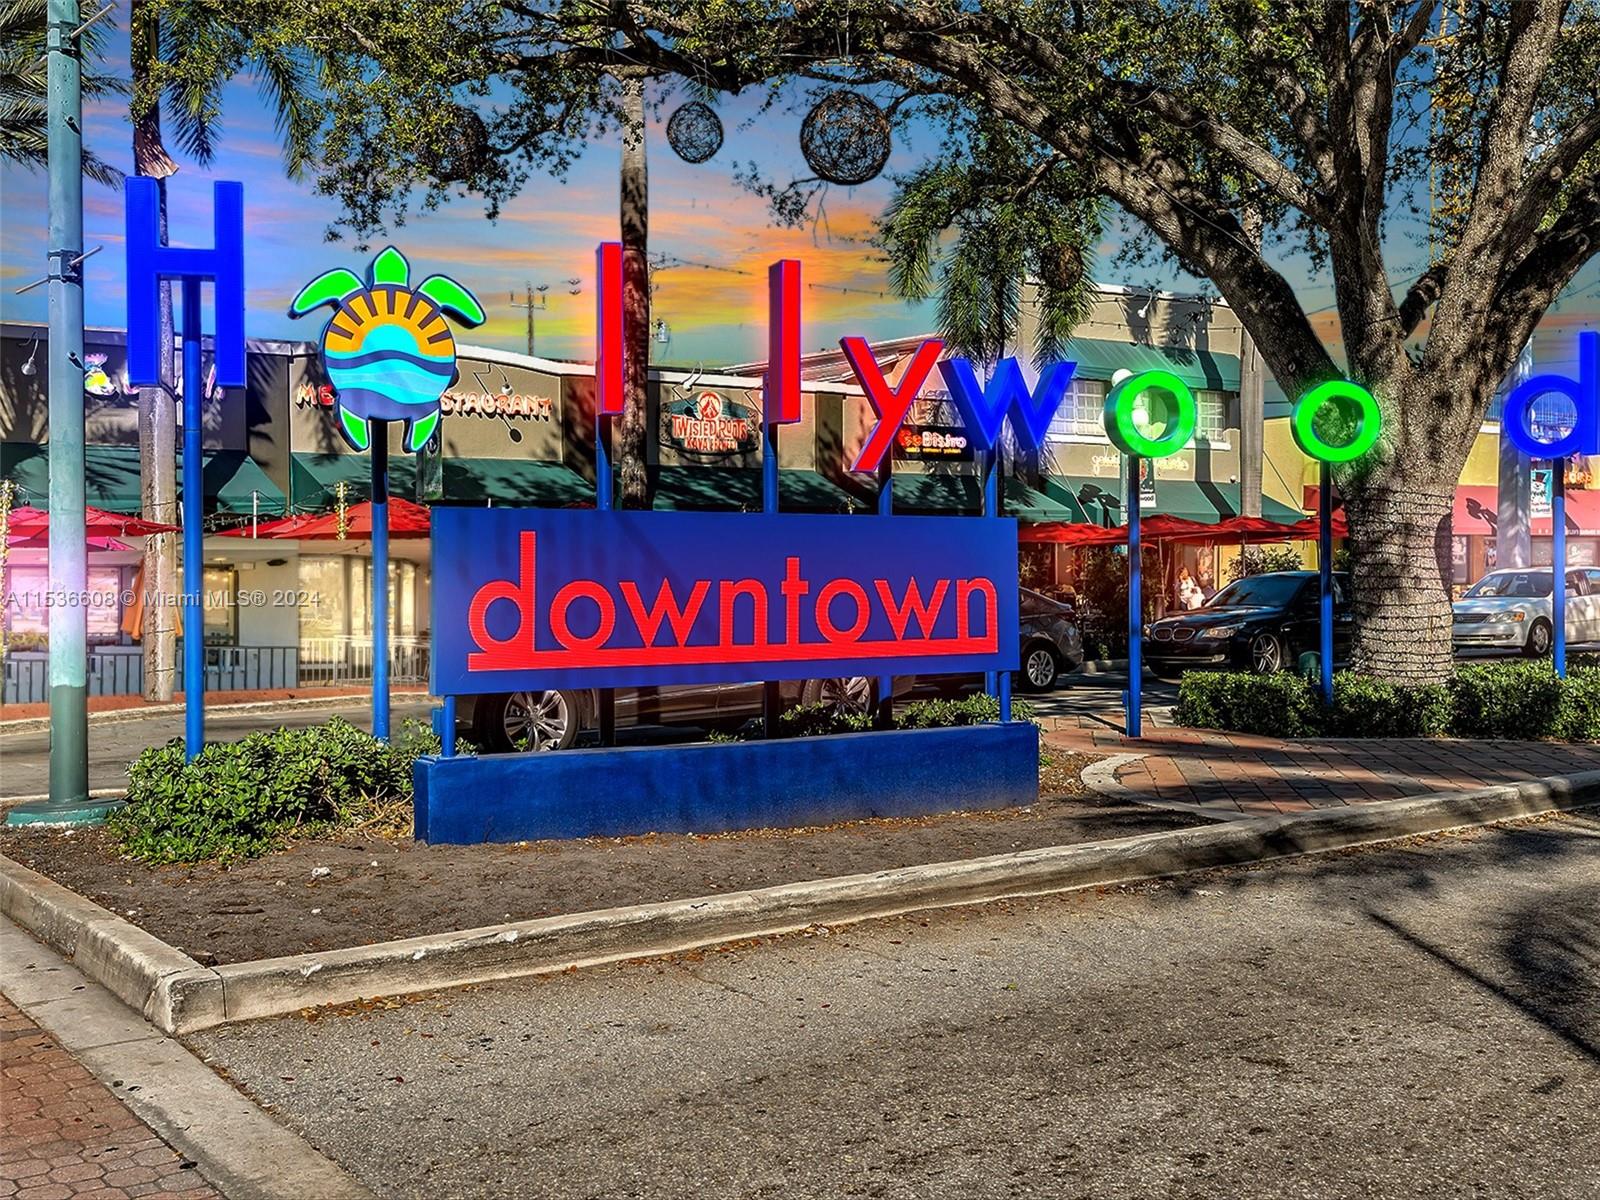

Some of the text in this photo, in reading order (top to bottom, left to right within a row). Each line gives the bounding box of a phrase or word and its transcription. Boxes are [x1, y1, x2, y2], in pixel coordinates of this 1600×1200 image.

[126, 176, 1600, 474] Hllywood
[671, 415, 718, 439] TWISTED
[467, 530, 999, 671] downtown
